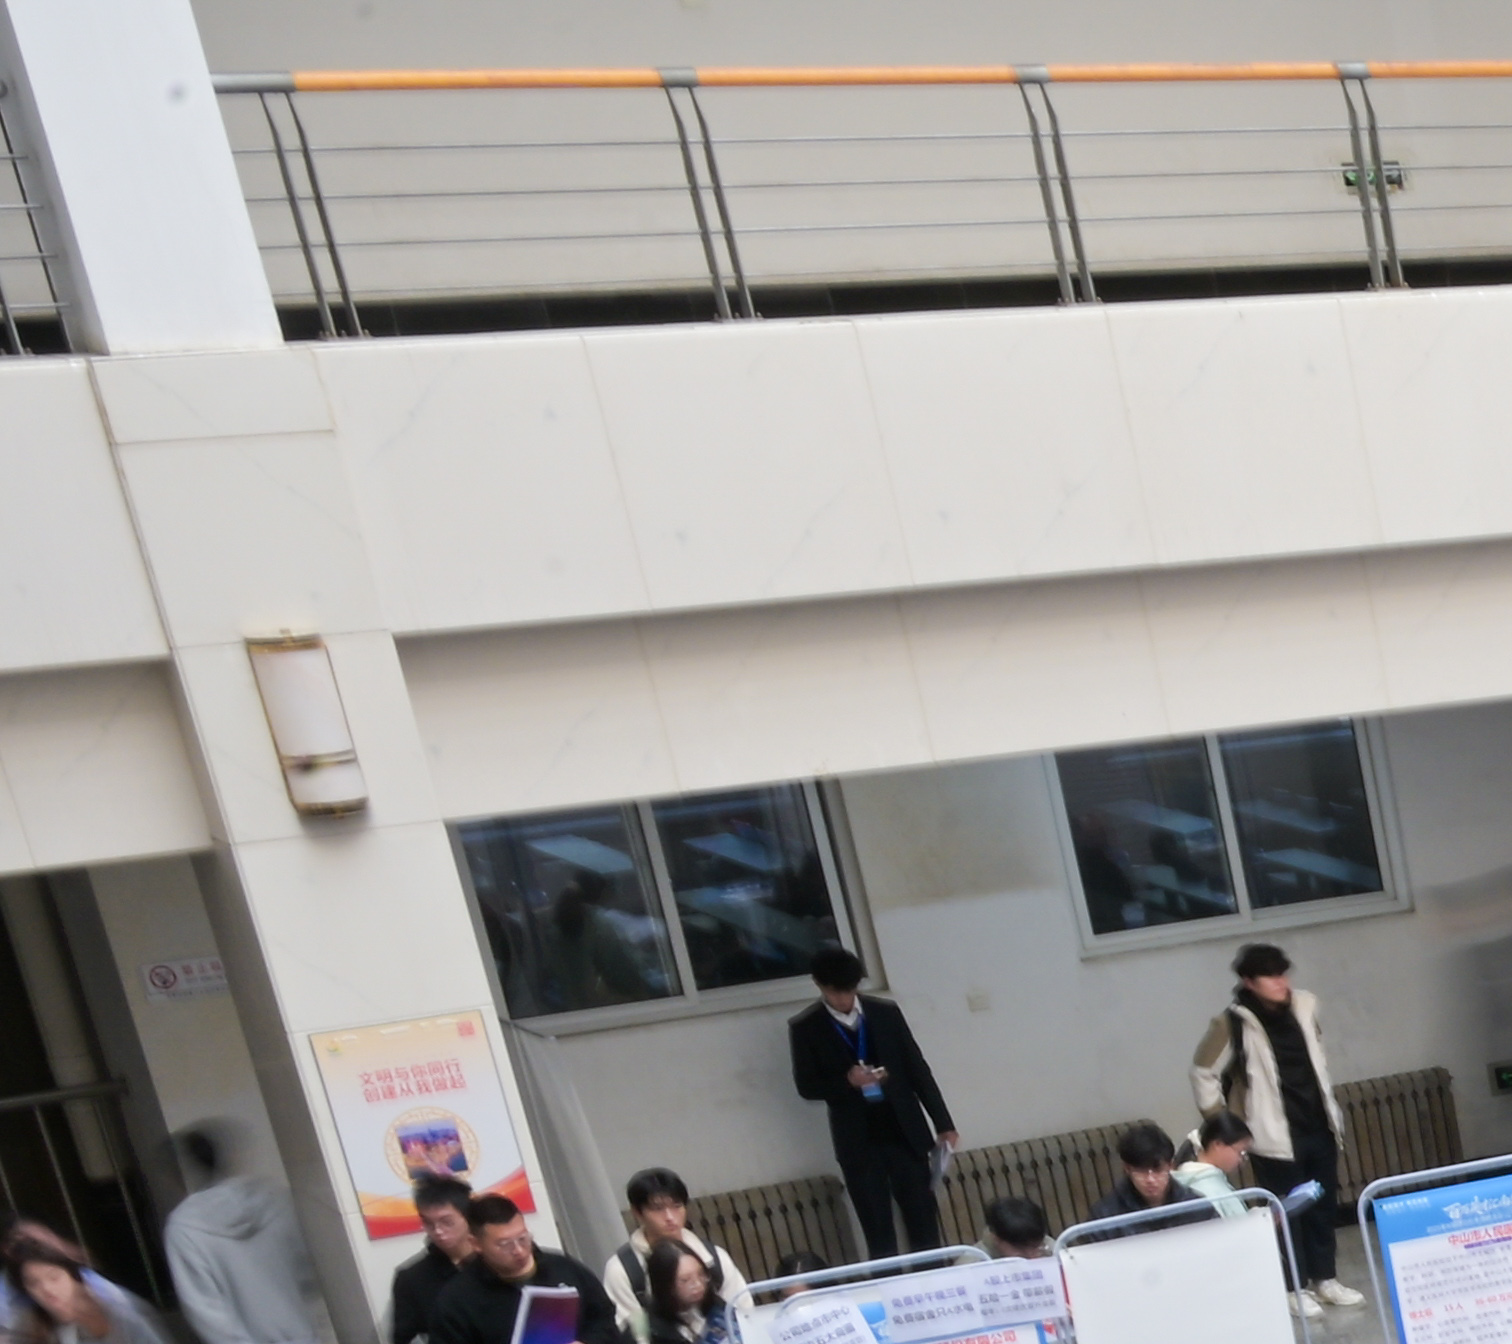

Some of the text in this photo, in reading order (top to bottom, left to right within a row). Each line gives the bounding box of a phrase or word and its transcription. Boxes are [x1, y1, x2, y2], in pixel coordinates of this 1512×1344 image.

[359, 1058, 462, 1086] 文明与你同行
[363, 1077, 467, 1104] 创建从我做起
